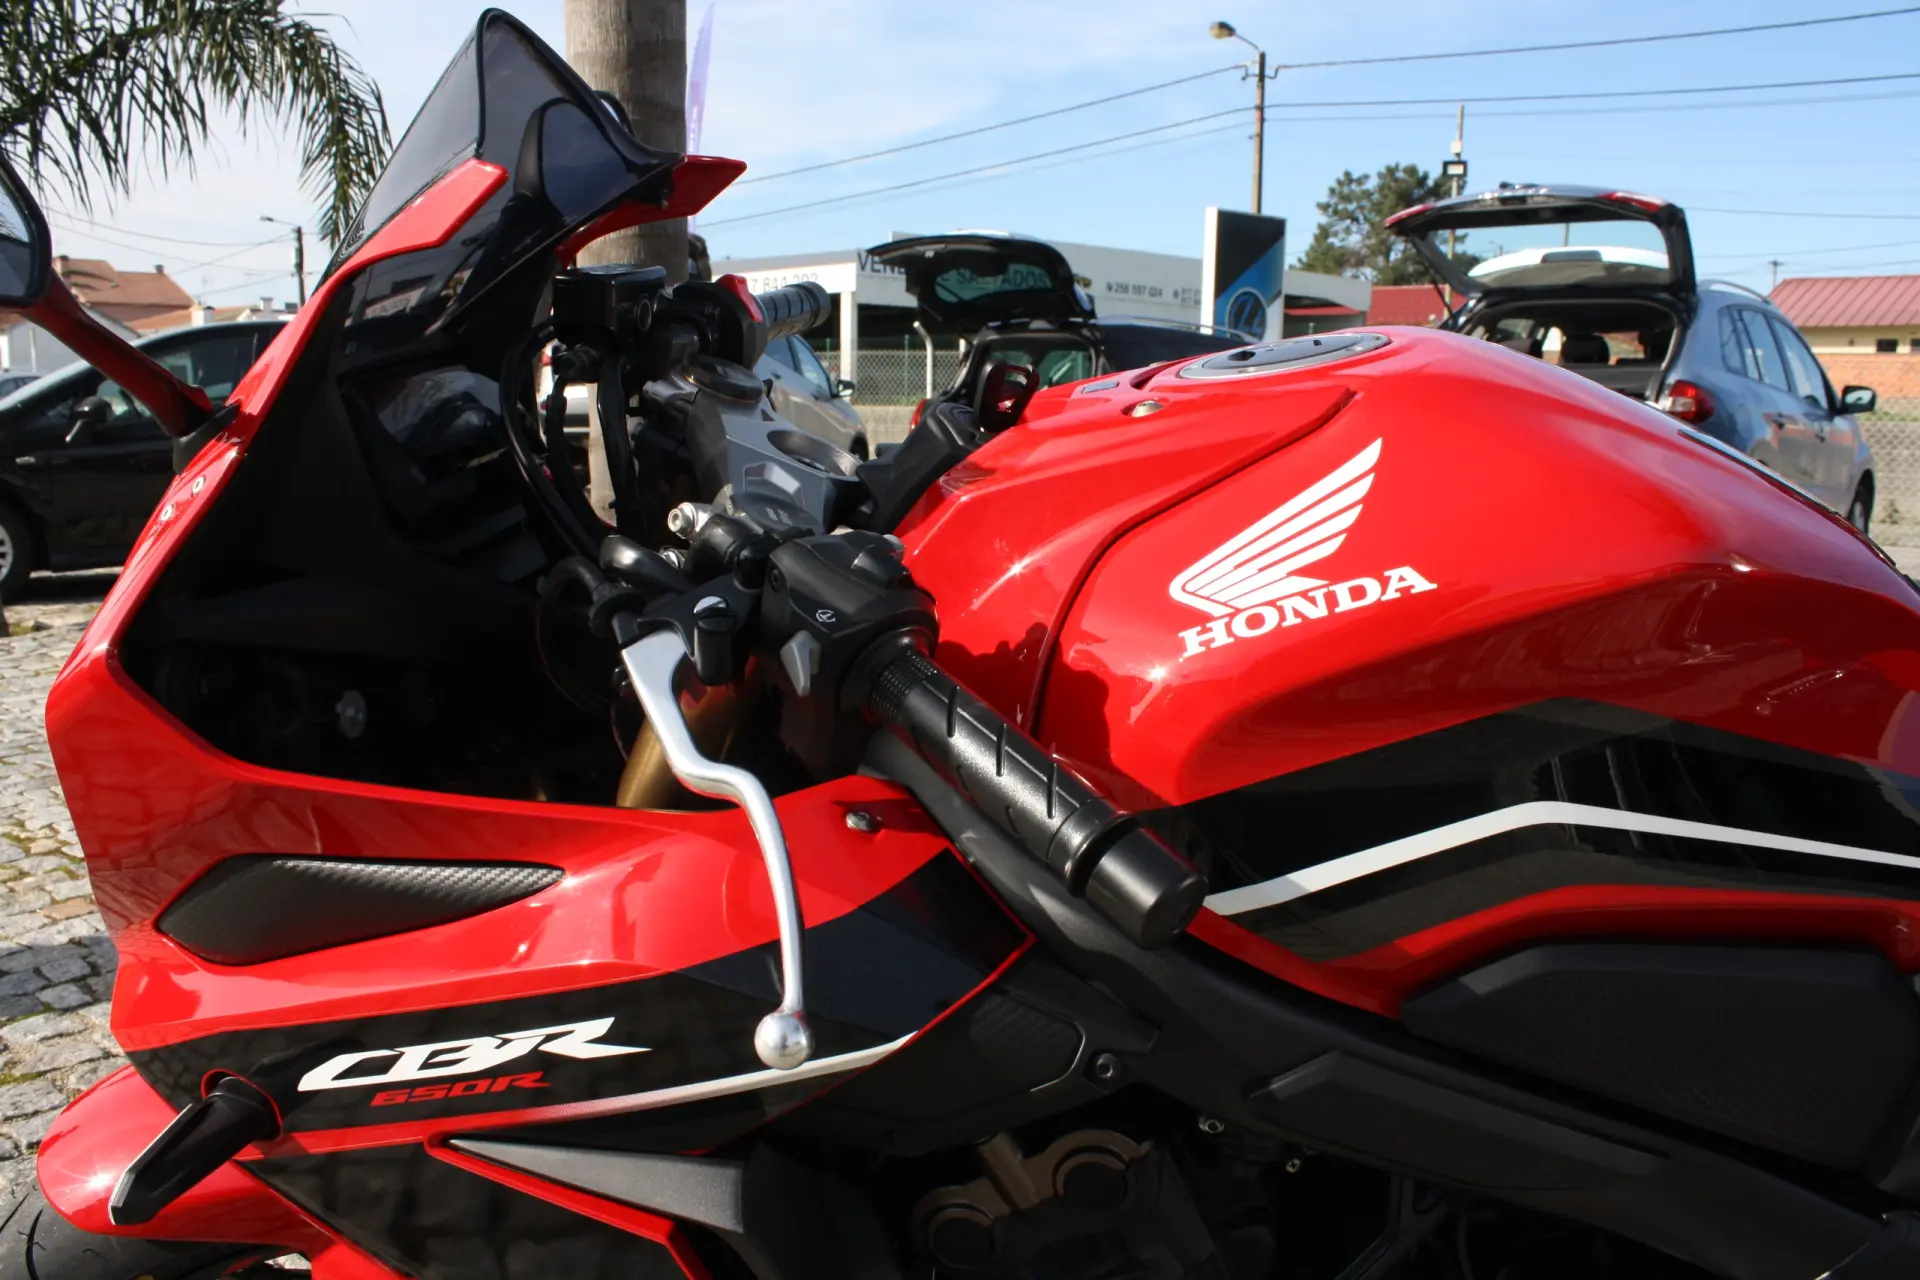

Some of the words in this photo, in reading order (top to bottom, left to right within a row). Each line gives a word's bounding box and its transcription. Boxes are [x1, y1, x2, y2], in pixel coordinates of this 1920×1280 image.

[1178, 565, 1438, 662] HONDA
[298, 1017, 652, 1091] CBR
[370, 1071, 551, 1107] 650R
